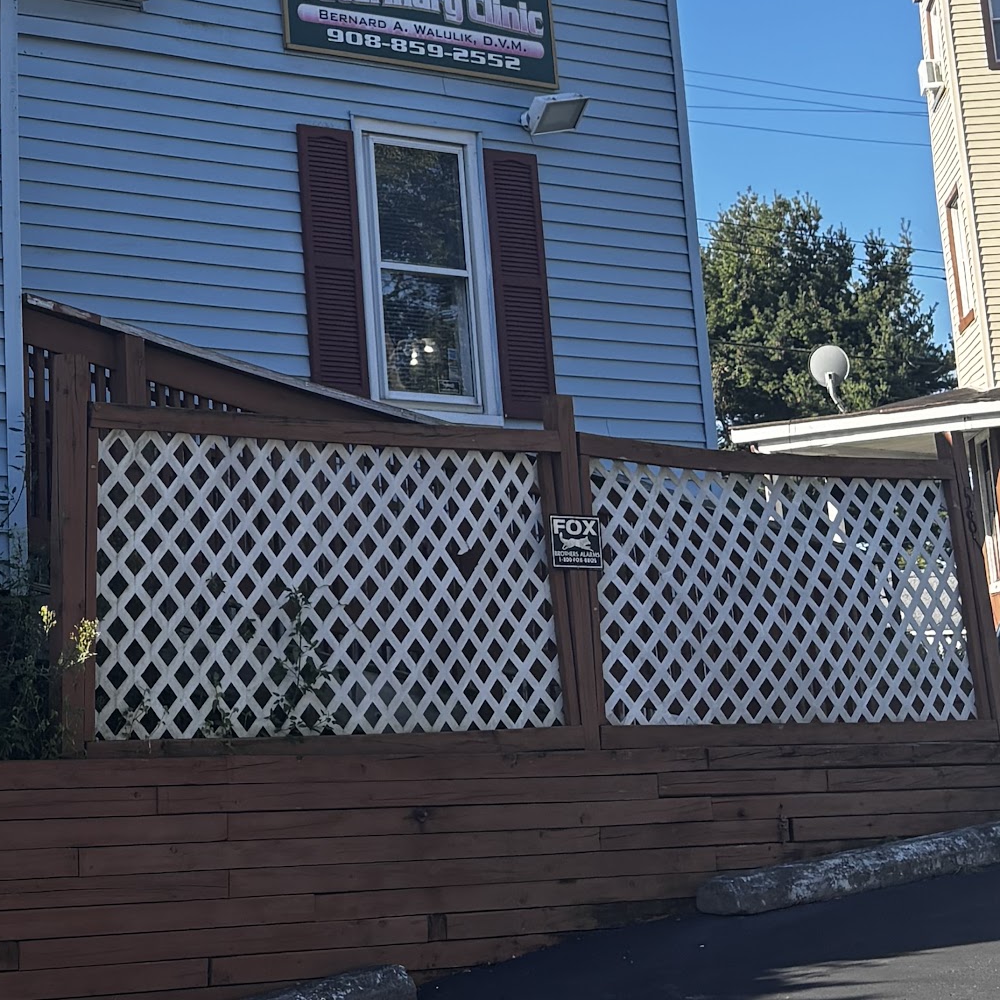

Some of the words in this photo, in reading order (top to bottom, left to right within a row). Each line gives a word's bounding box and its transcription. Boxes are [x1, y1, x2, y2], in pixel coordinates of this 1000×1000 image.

[318, 9, 387, 29] BERNARD
[393, 20, 408, 33] A.
[413, 24, 477, 46] WALULIK,
[483, 35, 528, 53] D.V.M.
[326, 28, 522, 71] 908-859-2552
[553, 519, 598, 536] FOX
